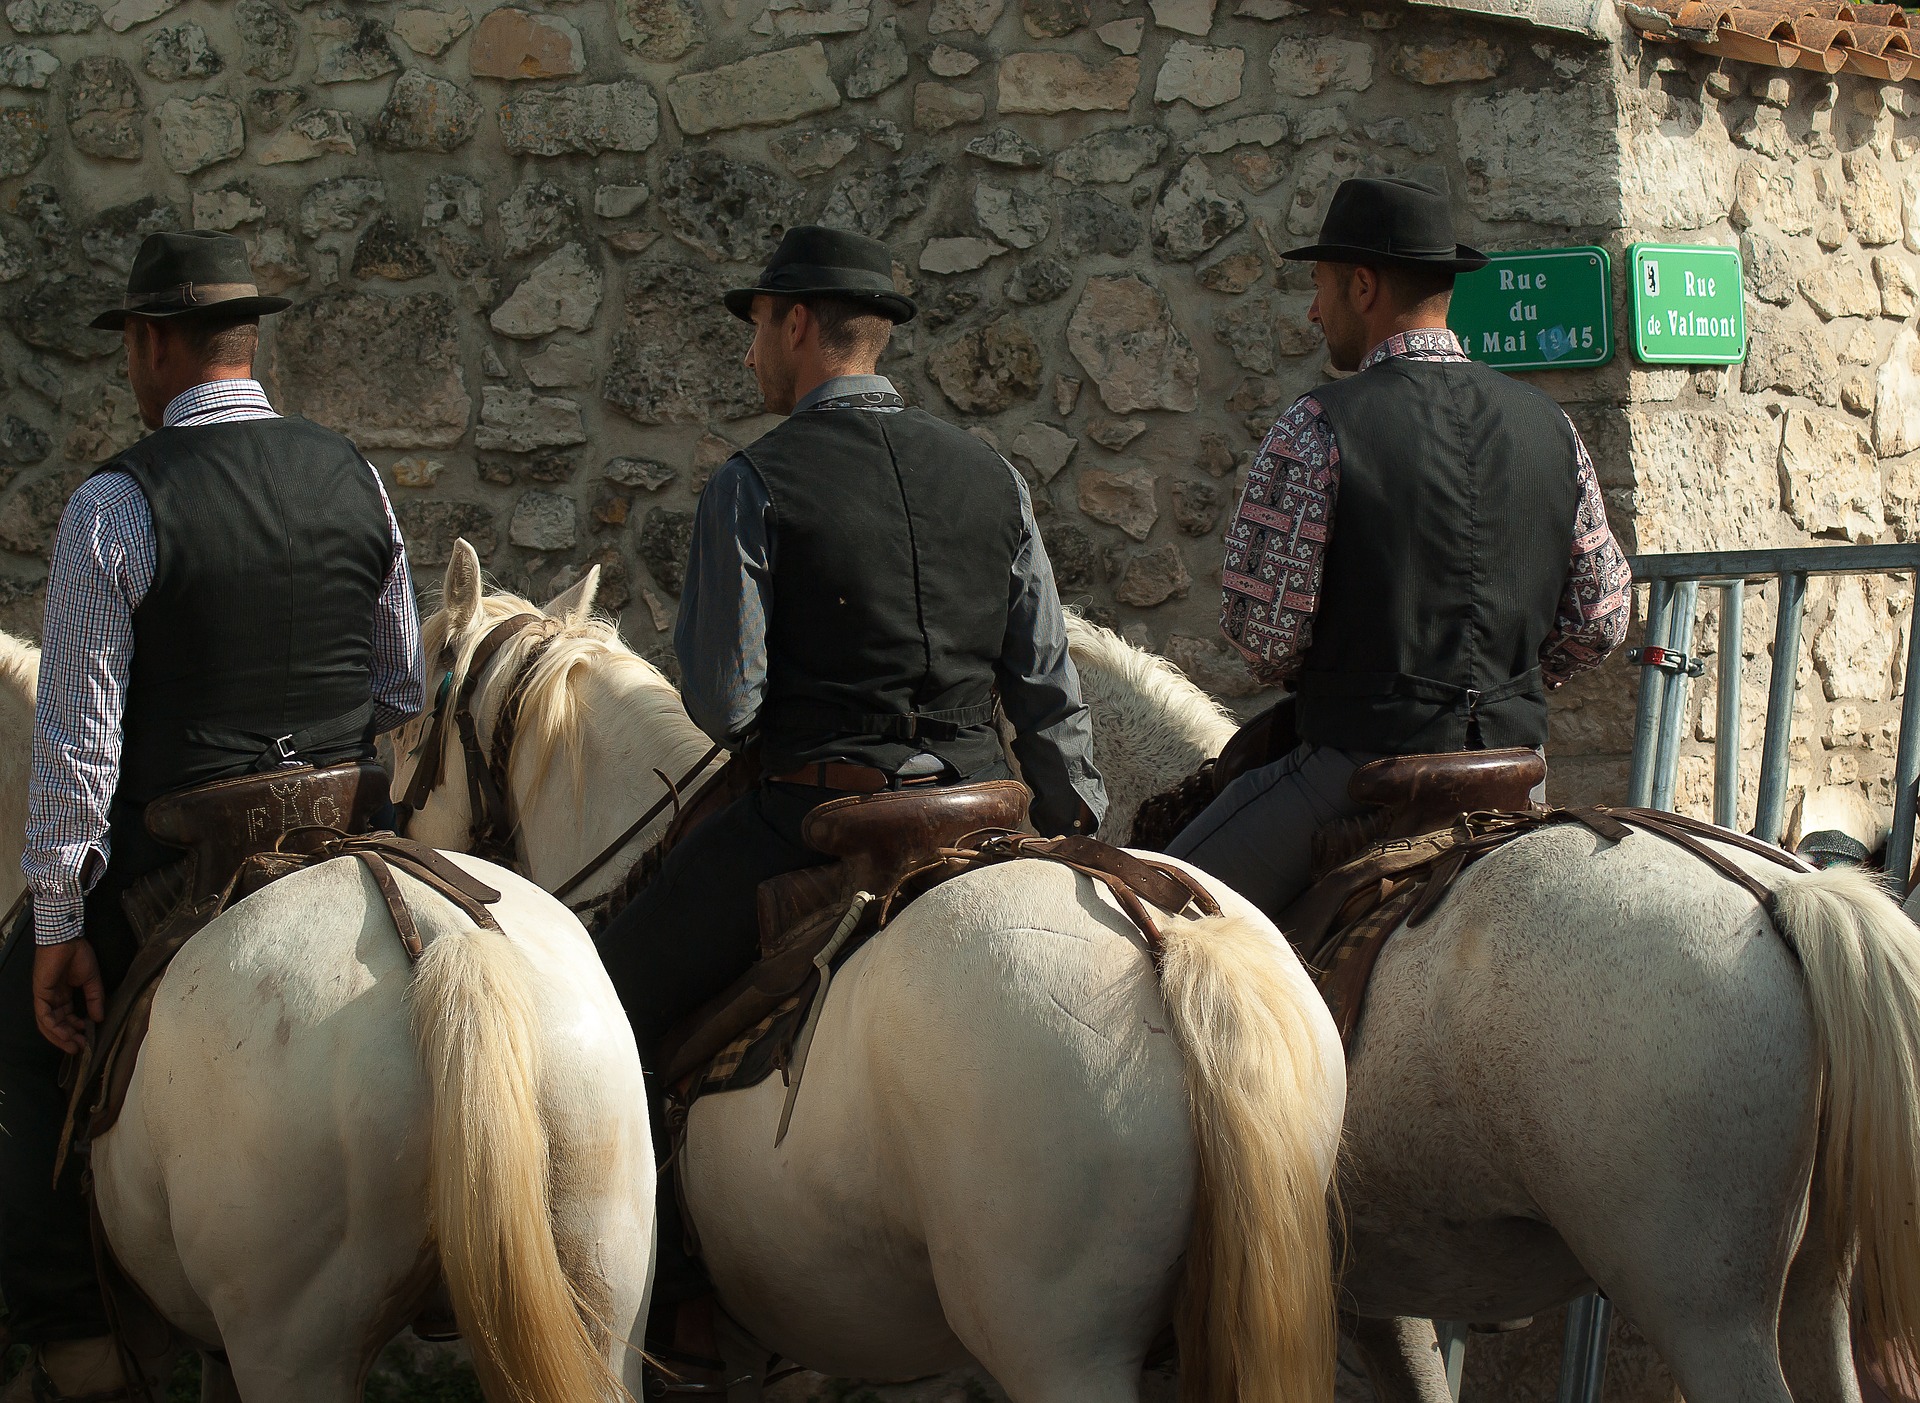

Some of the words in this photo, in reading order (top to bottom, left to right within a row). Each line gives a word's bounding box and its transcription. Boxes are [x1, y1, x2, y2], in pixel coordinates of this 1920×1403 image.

[1498, 269, 1548, 290] Rue
[1684, 271, 1716, 297] Rue
[1509, 300, 1538, 322] du
[1647, 315, 1662, 336] de
[1667, 310, 1737, 339] Valmont
[1482, 330, 1527, 353] Mai
